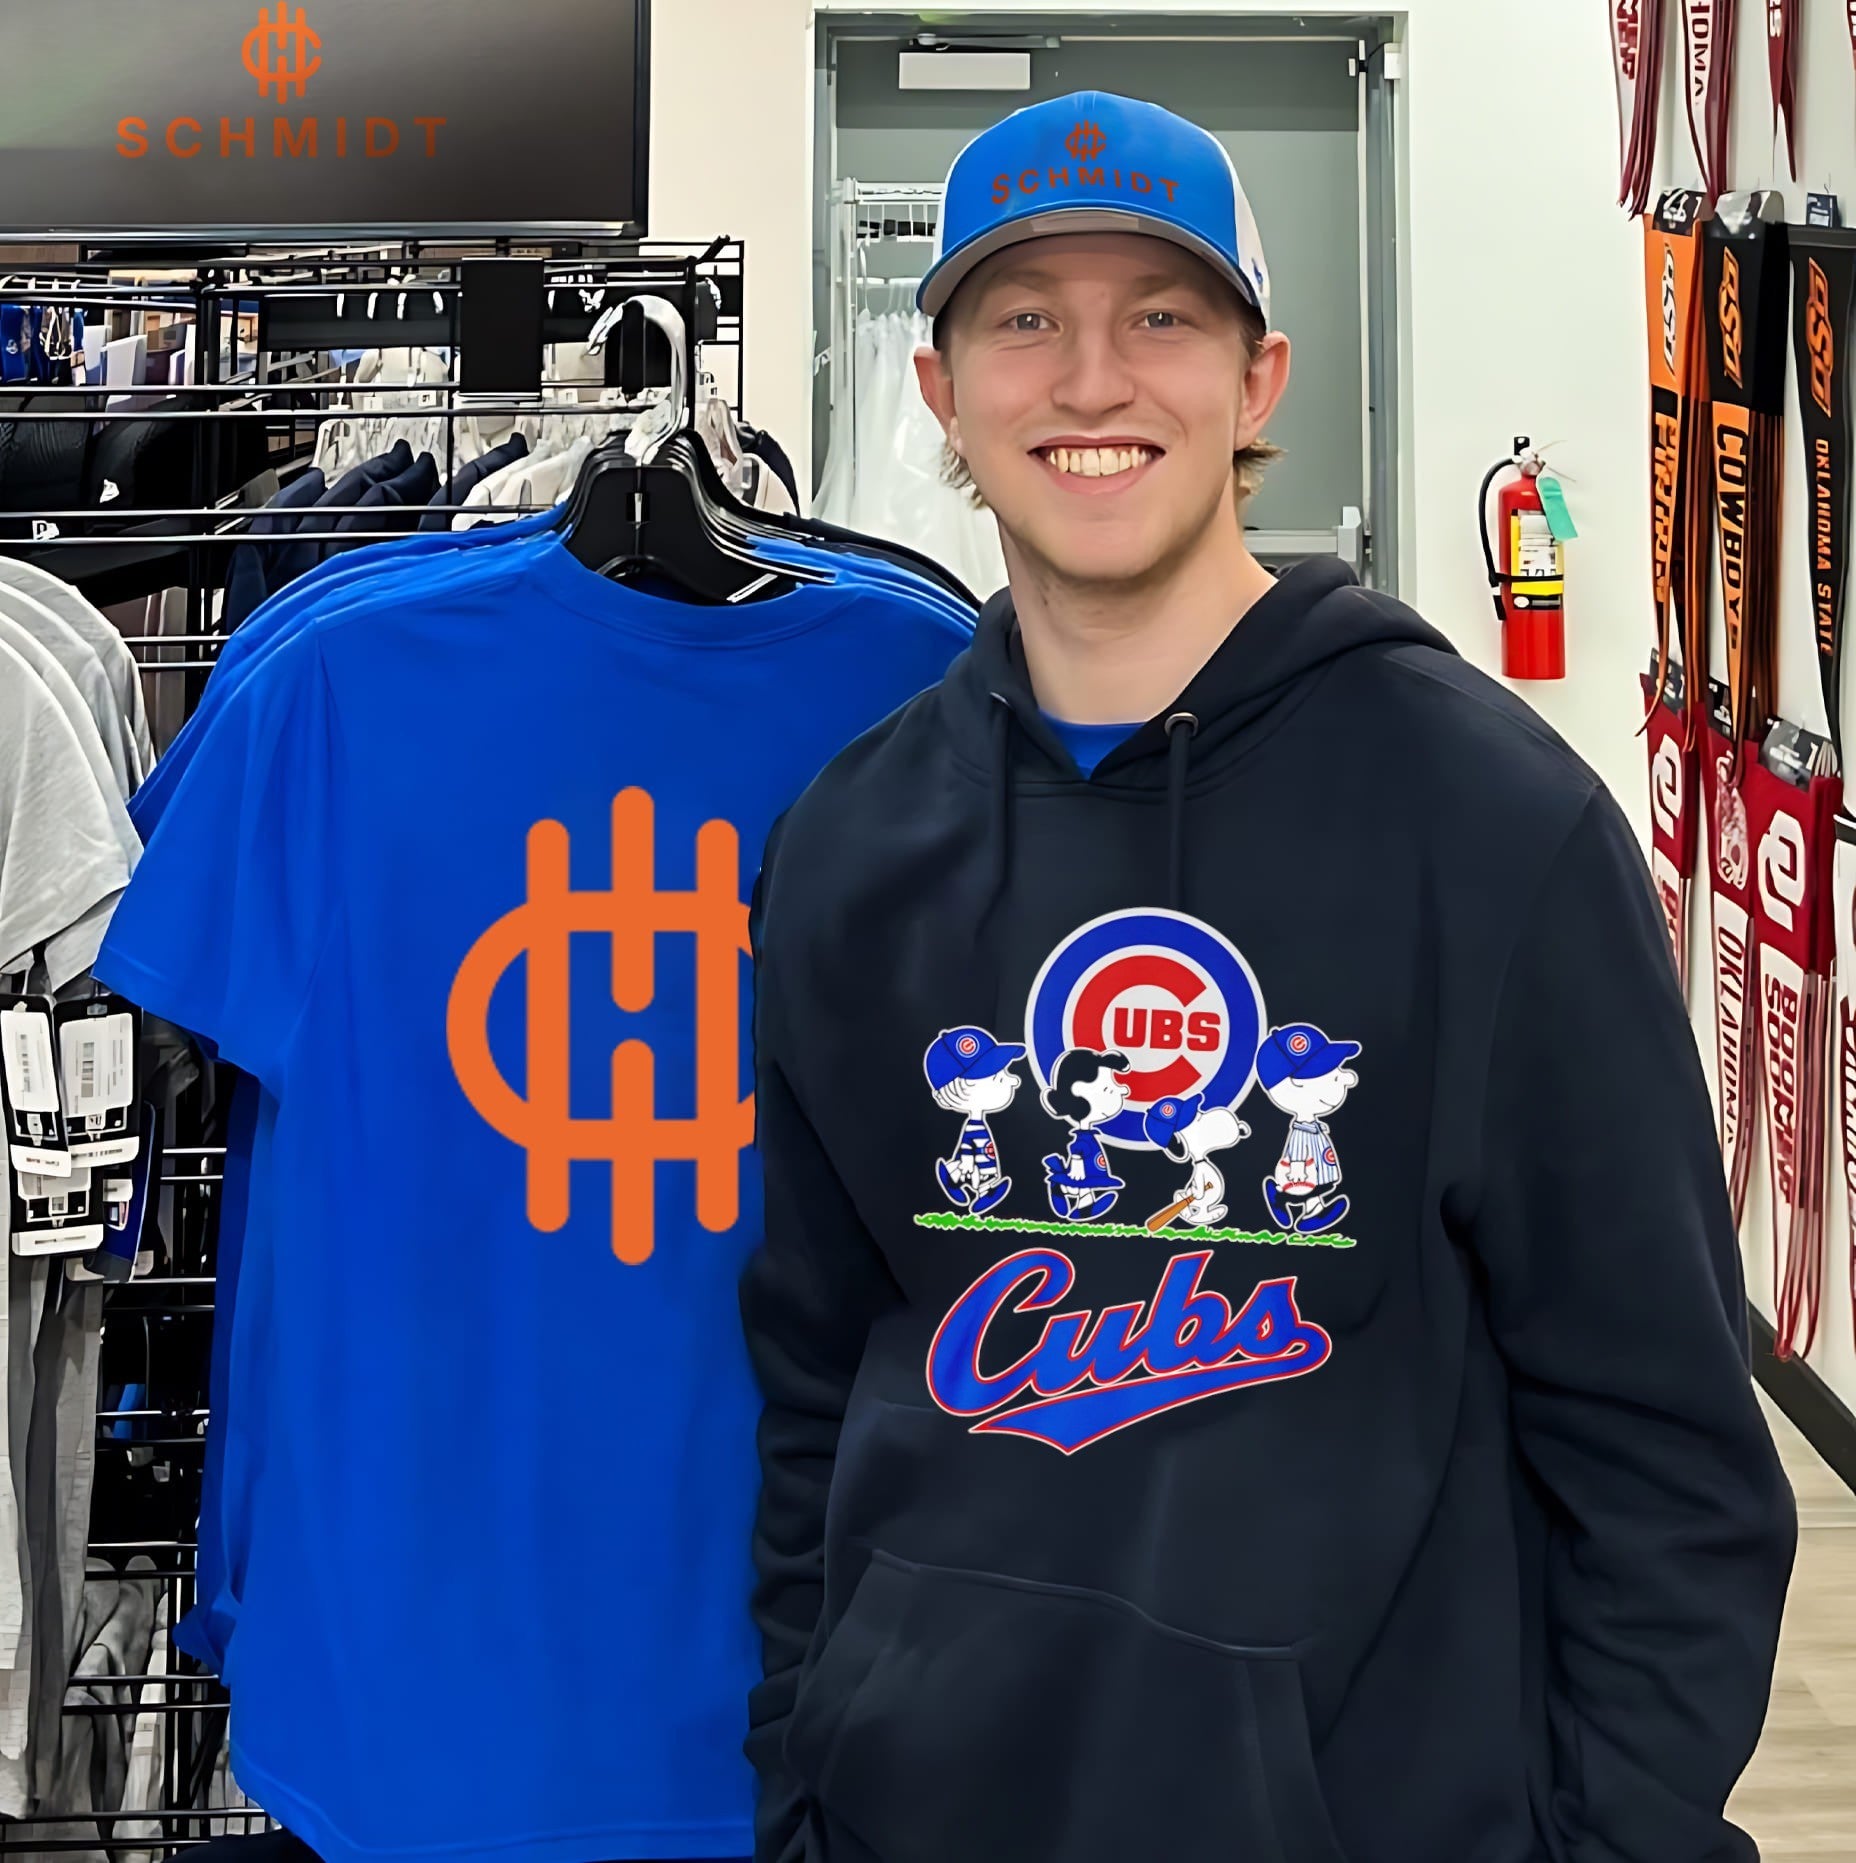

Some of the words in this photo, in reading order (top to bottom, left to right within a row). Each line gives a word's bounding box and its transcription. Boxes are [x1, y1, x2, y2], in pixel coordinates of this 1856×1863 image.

[115, 116, 447, 159] SCHMIDT
[991, 167, 1179, 204] SCHMIDT
[1815, 438, 1832, 570] OKLAHOMA
[927, 1247, 1331, 1418] Cubs
